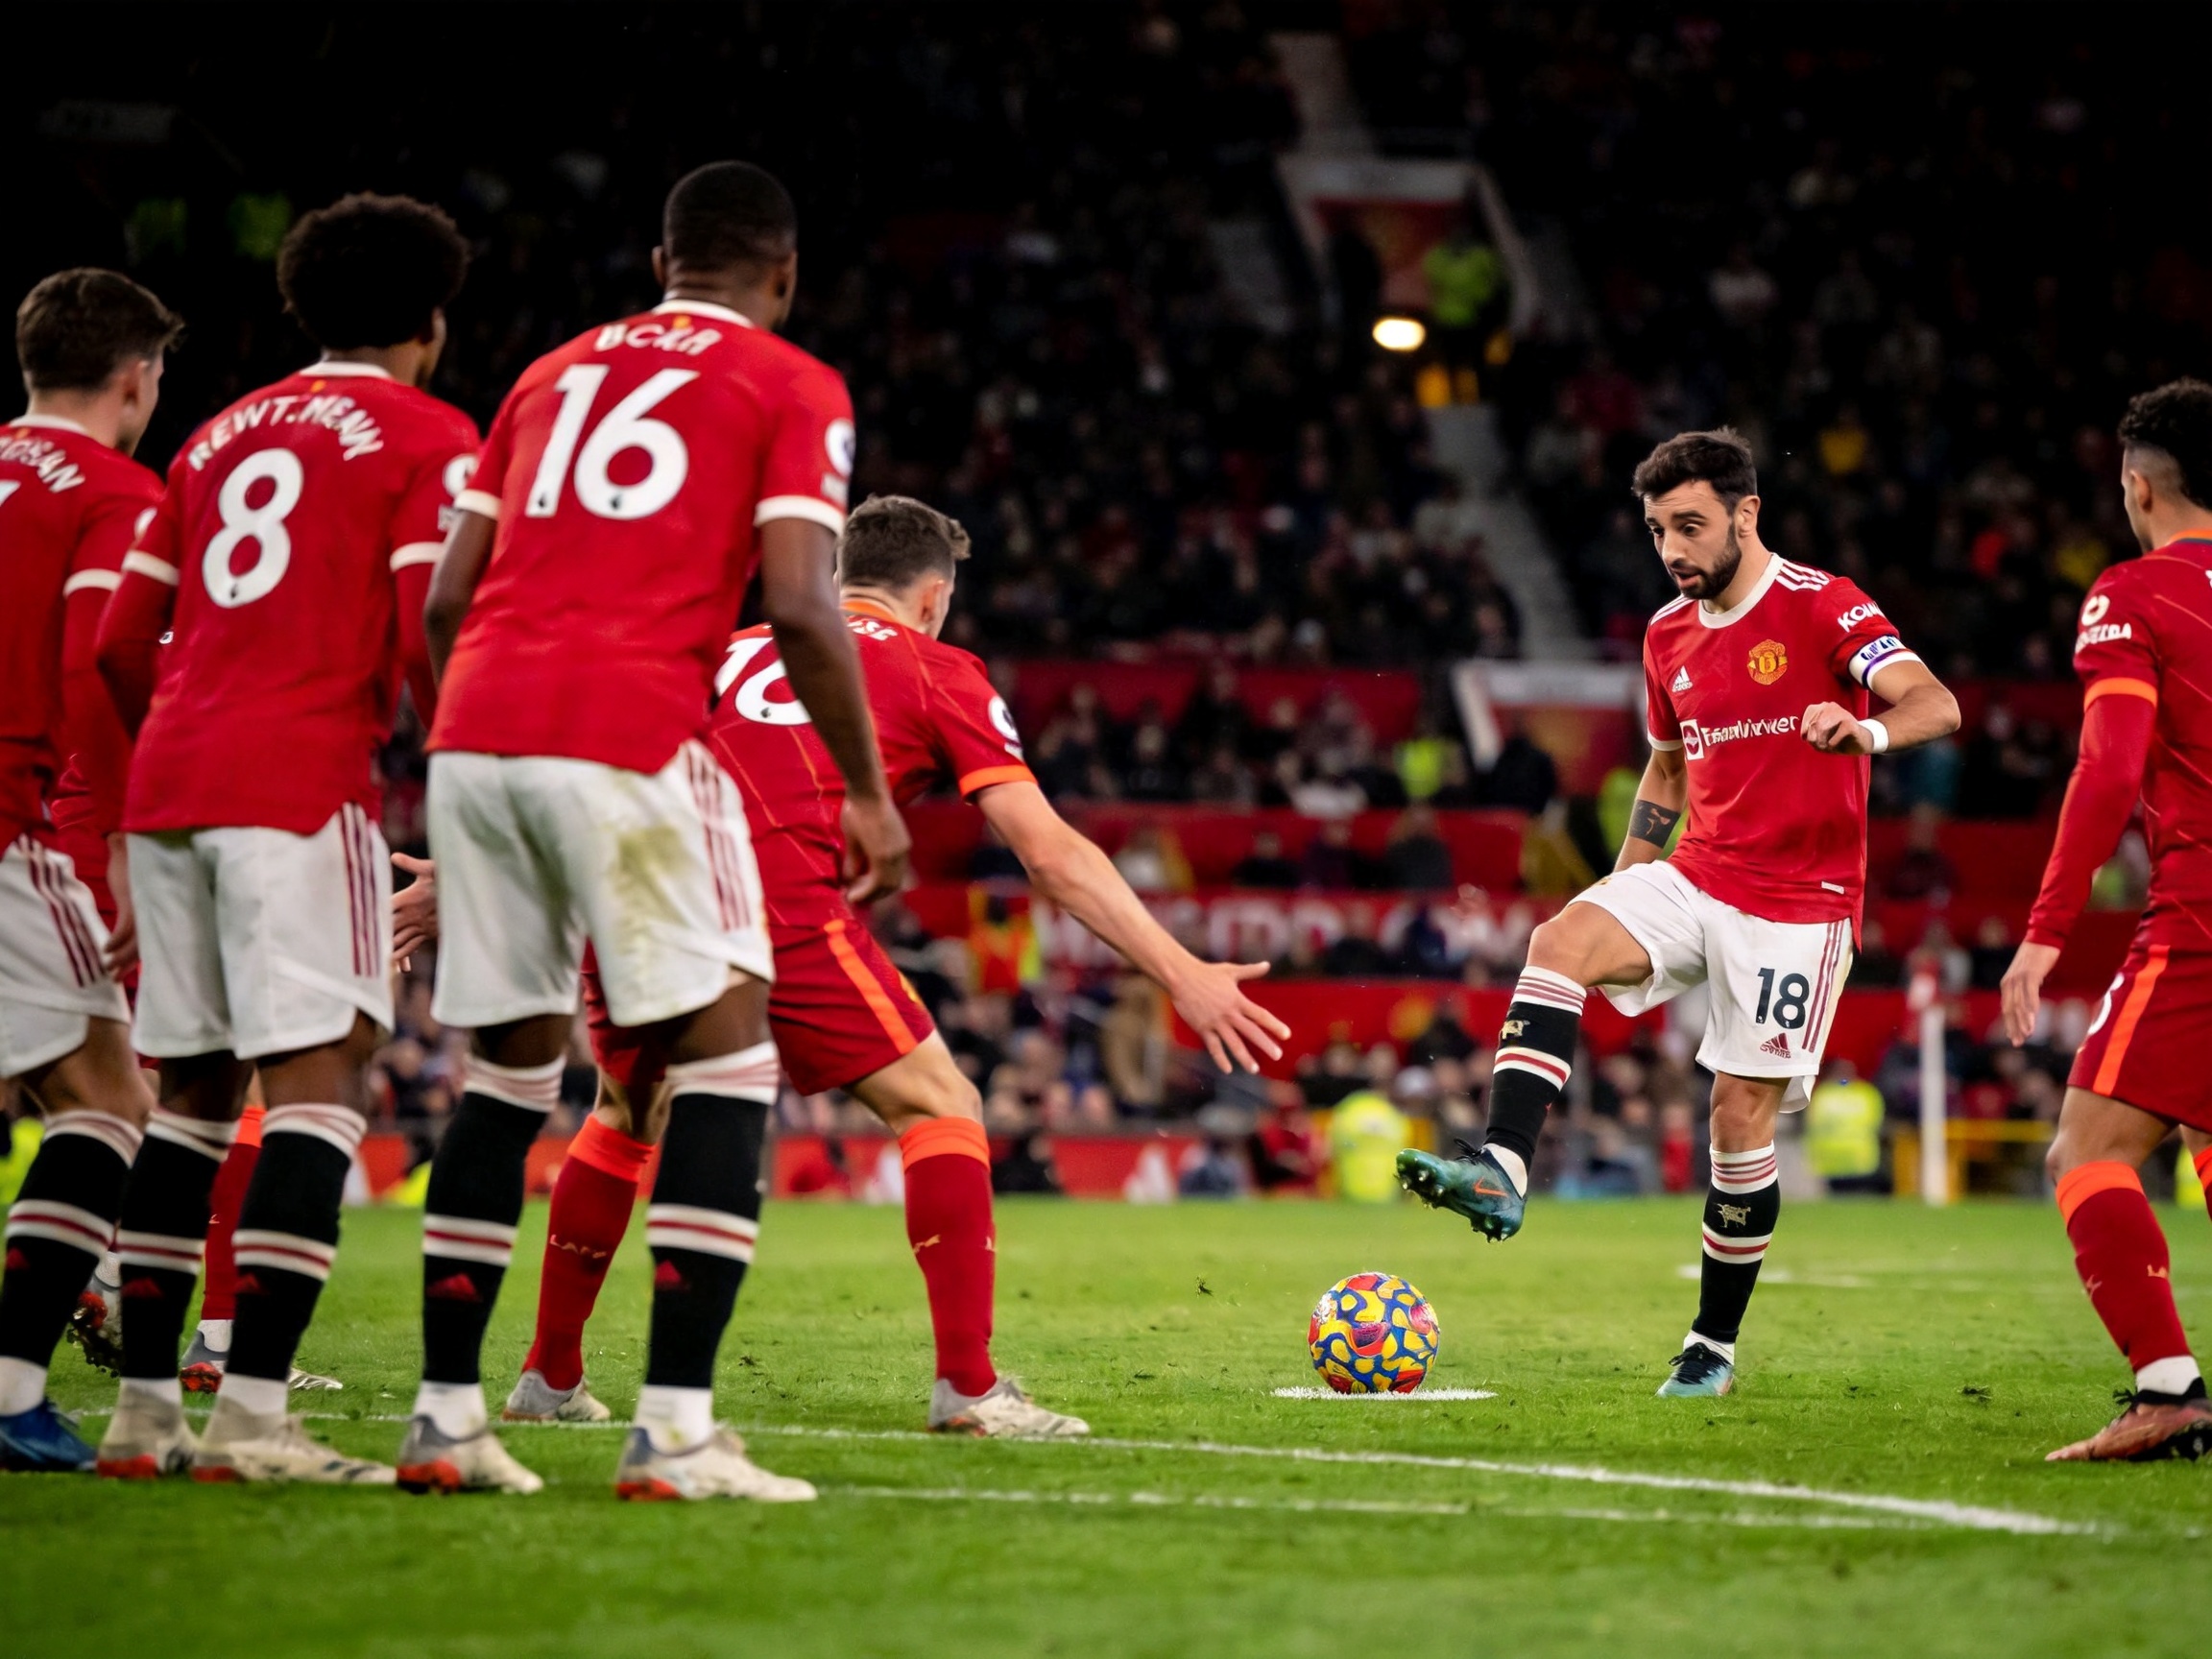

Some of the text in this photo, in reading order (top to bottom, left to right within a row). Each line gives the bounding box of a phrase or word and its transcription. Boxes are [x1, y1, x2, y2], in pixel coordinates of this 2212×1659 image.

[524, 363, 700, 520] 16
[202, 447, 304, 609] 8
[1755, 967, 1811, 1030] 18
